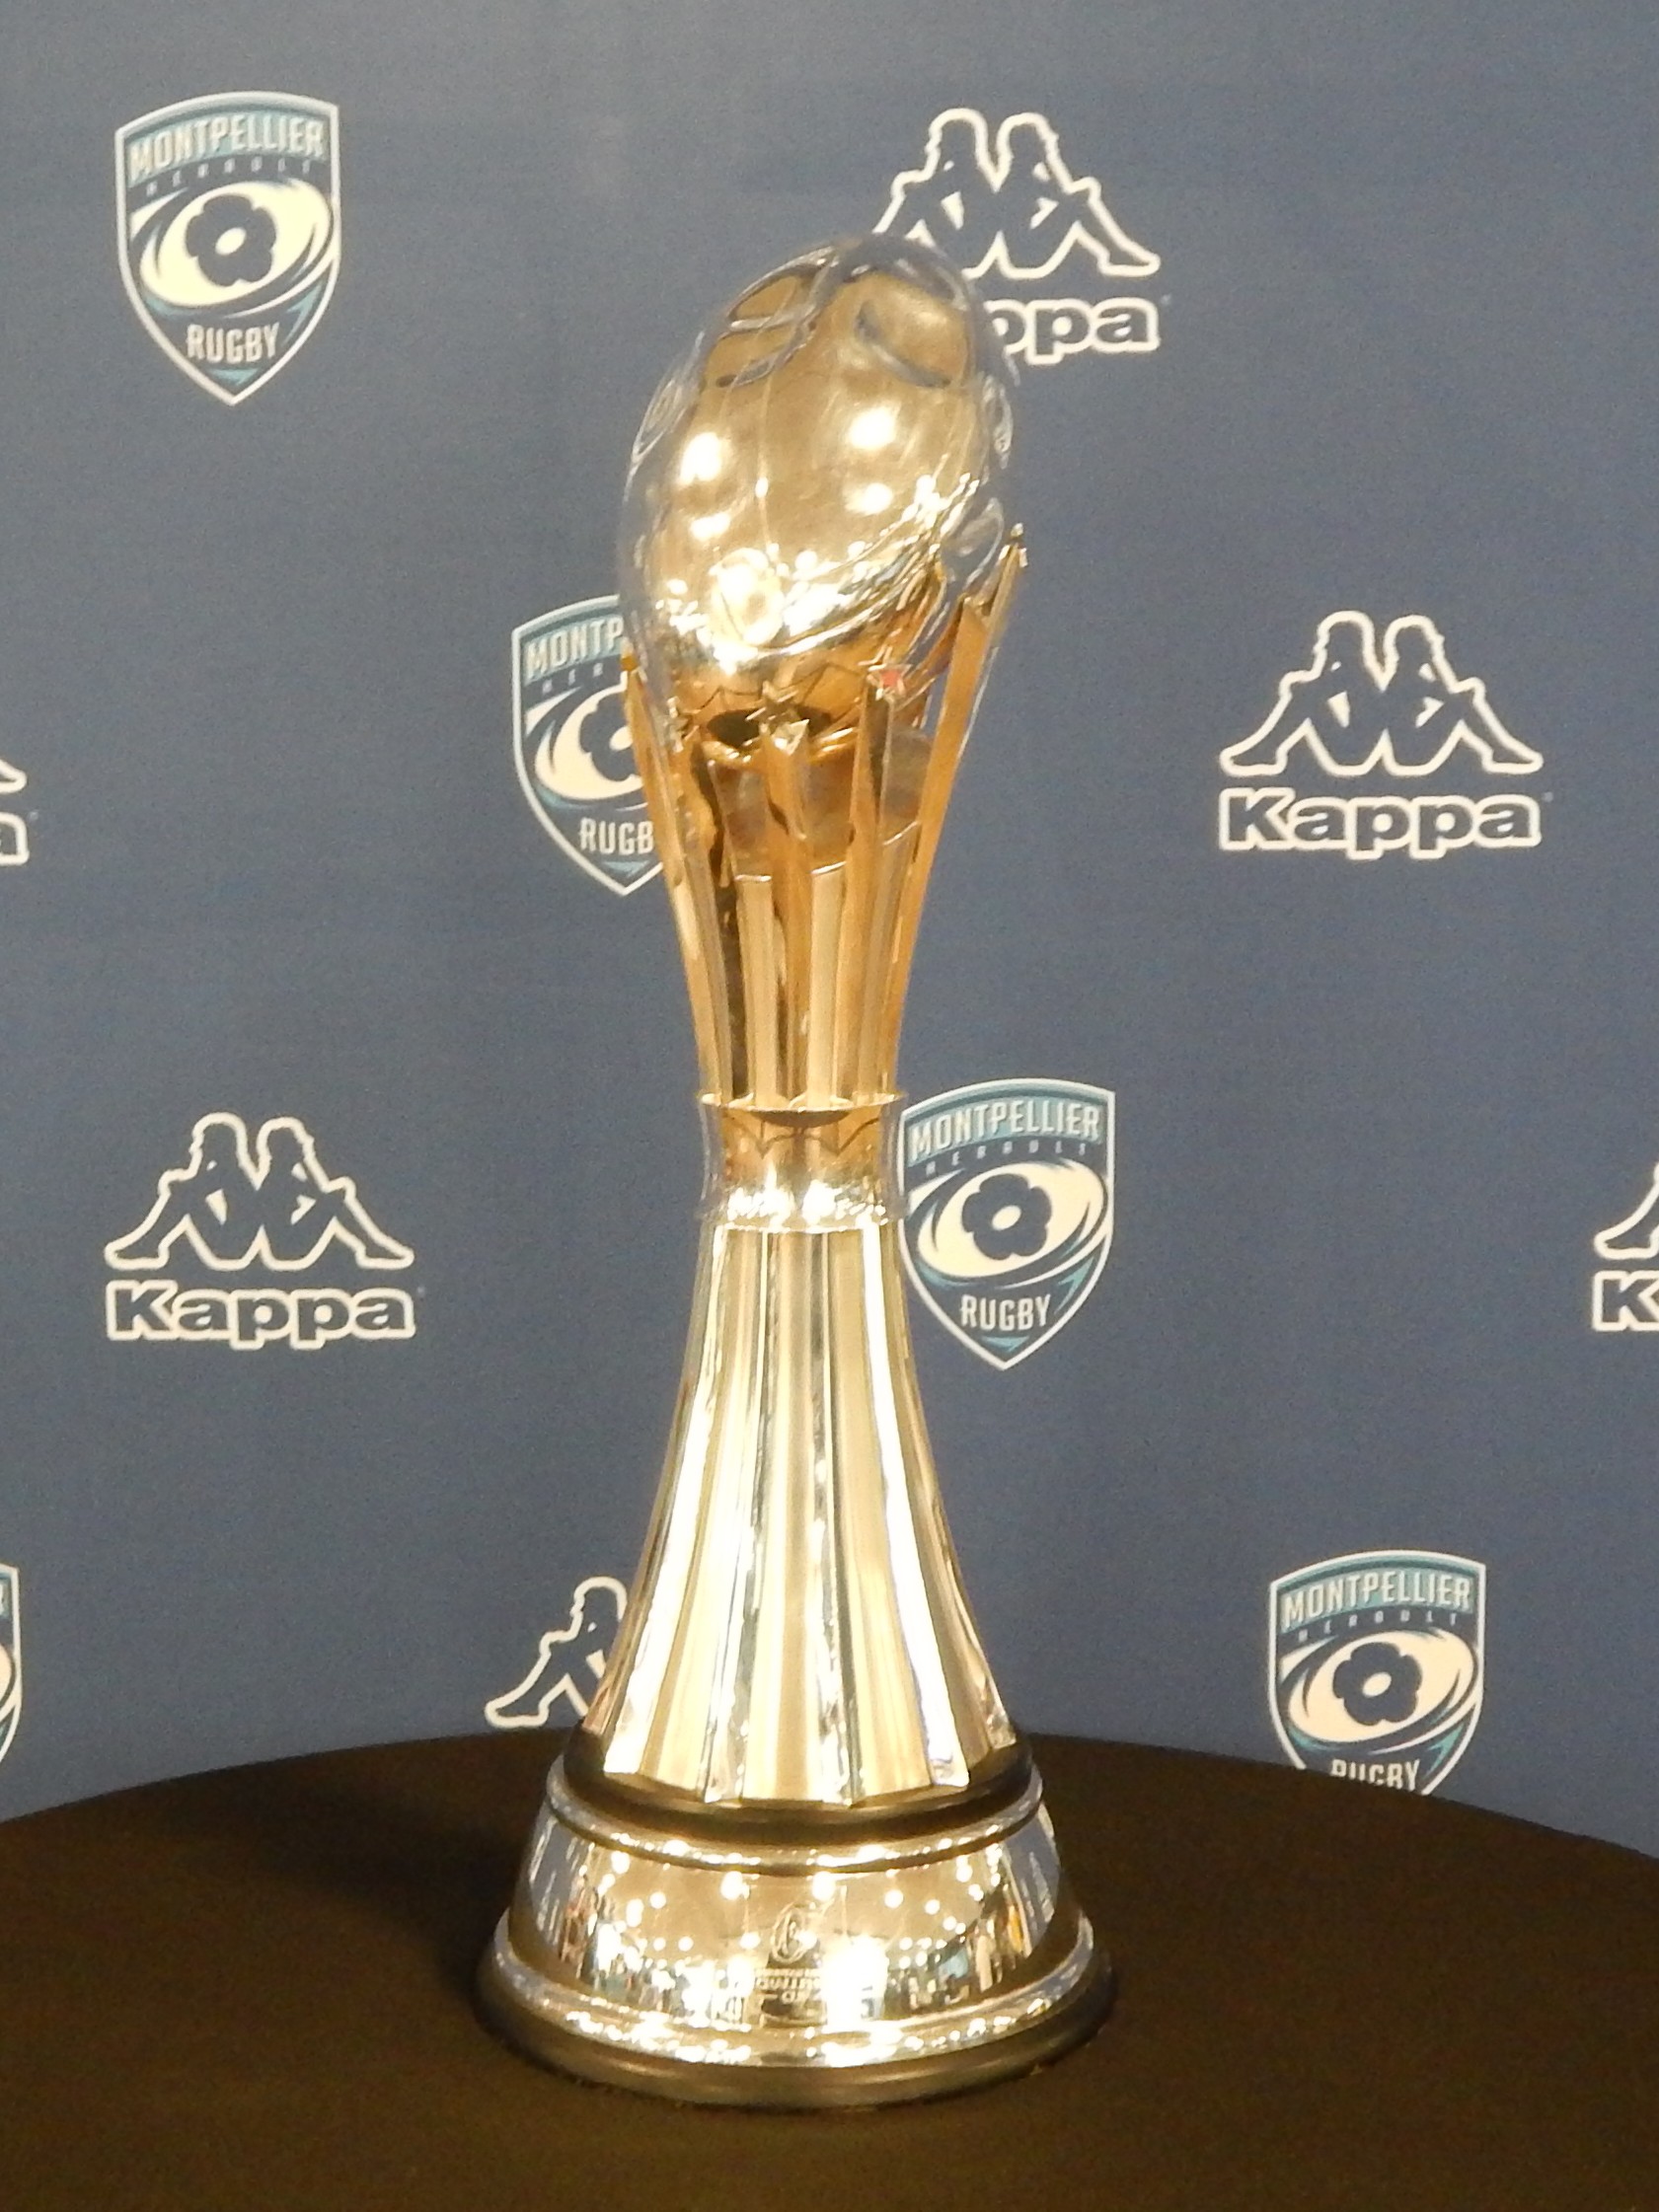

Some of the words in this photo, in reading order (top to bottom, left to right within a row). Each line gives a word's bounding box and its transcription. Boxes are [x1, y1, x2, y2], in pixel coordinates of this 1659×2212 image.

[128, 113, 324, 184] MONTPELLIER
[185, 321, 280, 364] RUGBY
[983, 297, 1162, 366] ppa
[577, 817, 654, 855] RUGB
[1218, 786, 1543, 860] Kappa
[911, 1099, 1101, 1162] MONTPELLIER
[105, 1280, 416, 1351] Kappa
[959, 1293, 1051, 1332] RUGBY
[1283, 1570, 1471, 1633] MONTPELLIER
